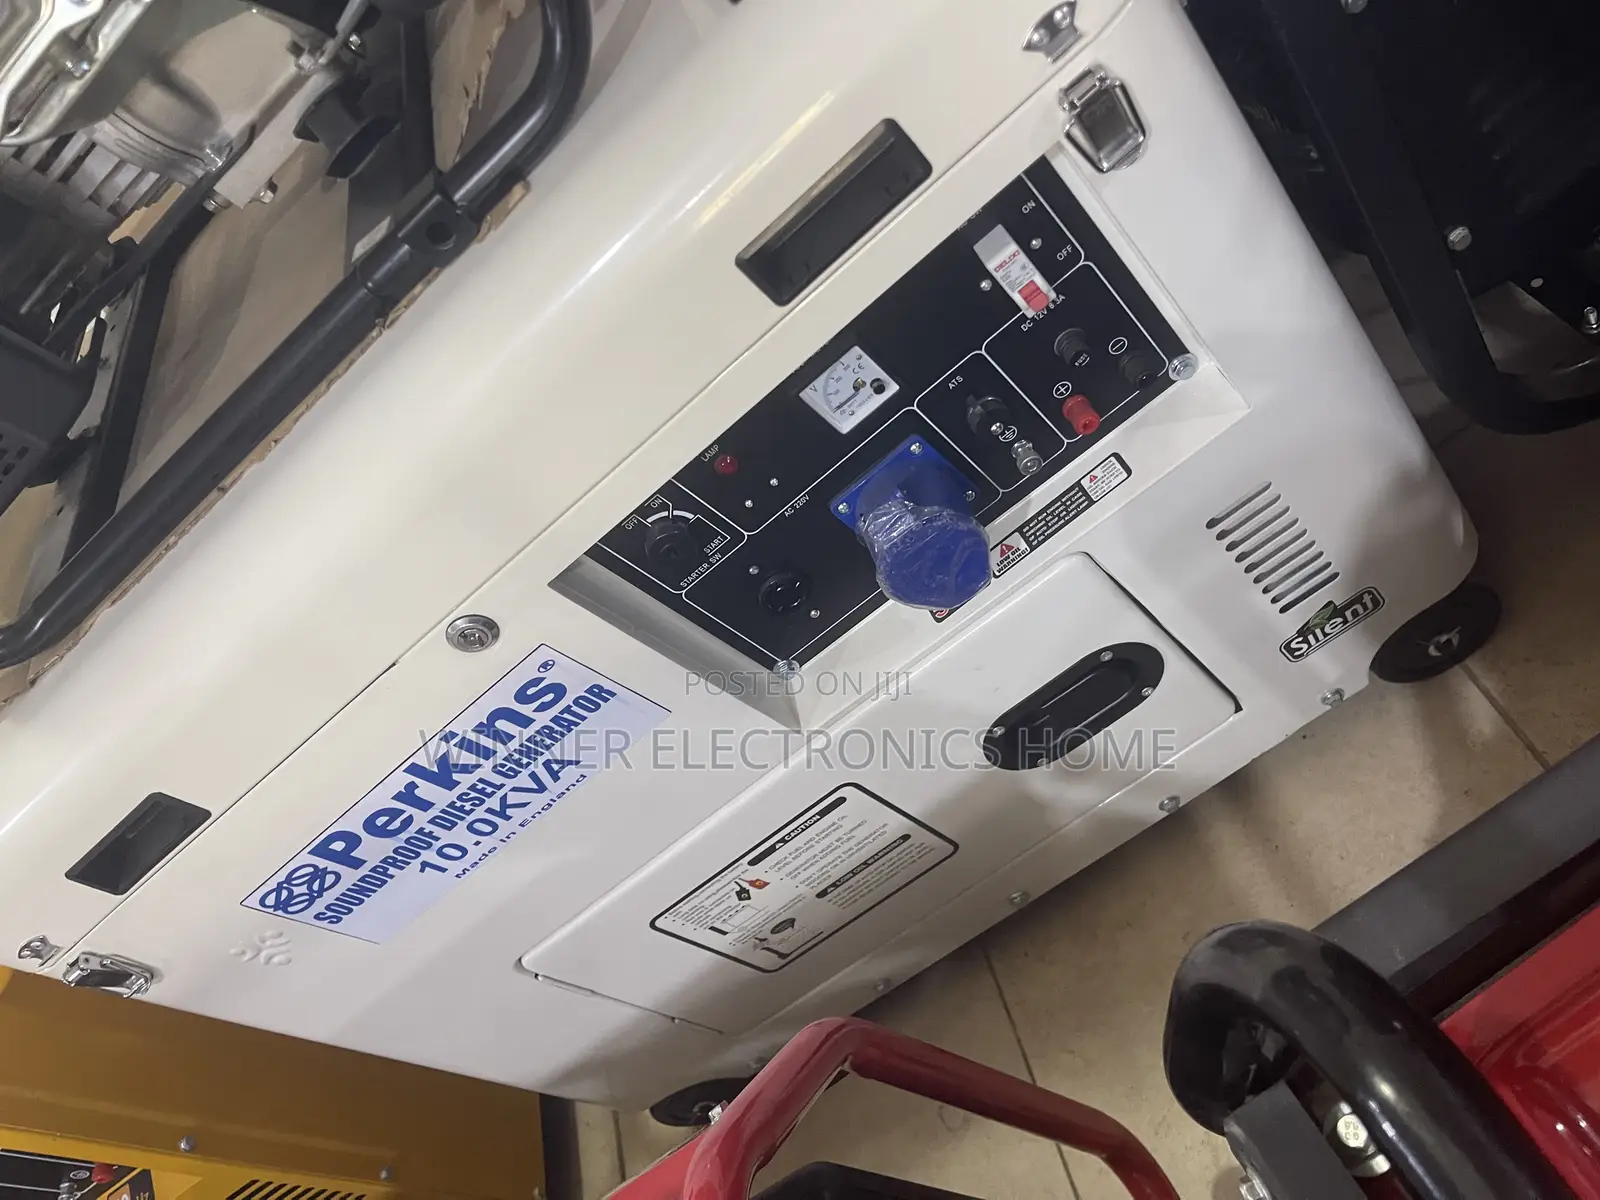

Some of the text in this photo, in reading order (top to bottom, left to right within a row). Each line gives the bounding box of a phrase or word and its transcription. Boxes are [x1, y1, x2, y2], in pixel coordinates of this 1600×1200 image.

[1021, 200, 1036, 214] ON
[1056, 244, 1073, 261] OFF
[1020, 320, 1033, 332] DC
[1034, 307, 1047, 321] 12V
[948, 375, 964, 390] ATS
[701, 444, 720, 462] LAMP
[650, 497, 663, 509] ON
[783, 494, 810, 518] AC 220V
[625, 518, 639, 531] OFF
[703, 535, 724, 554] START
[996, 547, 1020, 567] LOW OIL
[997, 547, 1029, 574] WARNING!
[680, 552, 722, 588] STARTER SW
[1289, 592, 1374, 656] Silent
[313, 683, 618, 925] SOUNDPROOF DIESEL GENERATOR
[419, 758, 584, 875] 10.0KVA
[455, 845, 498, 879] Made
[518, 773, 588, 828] England
[784, 815, 820, 840] CAUTION
